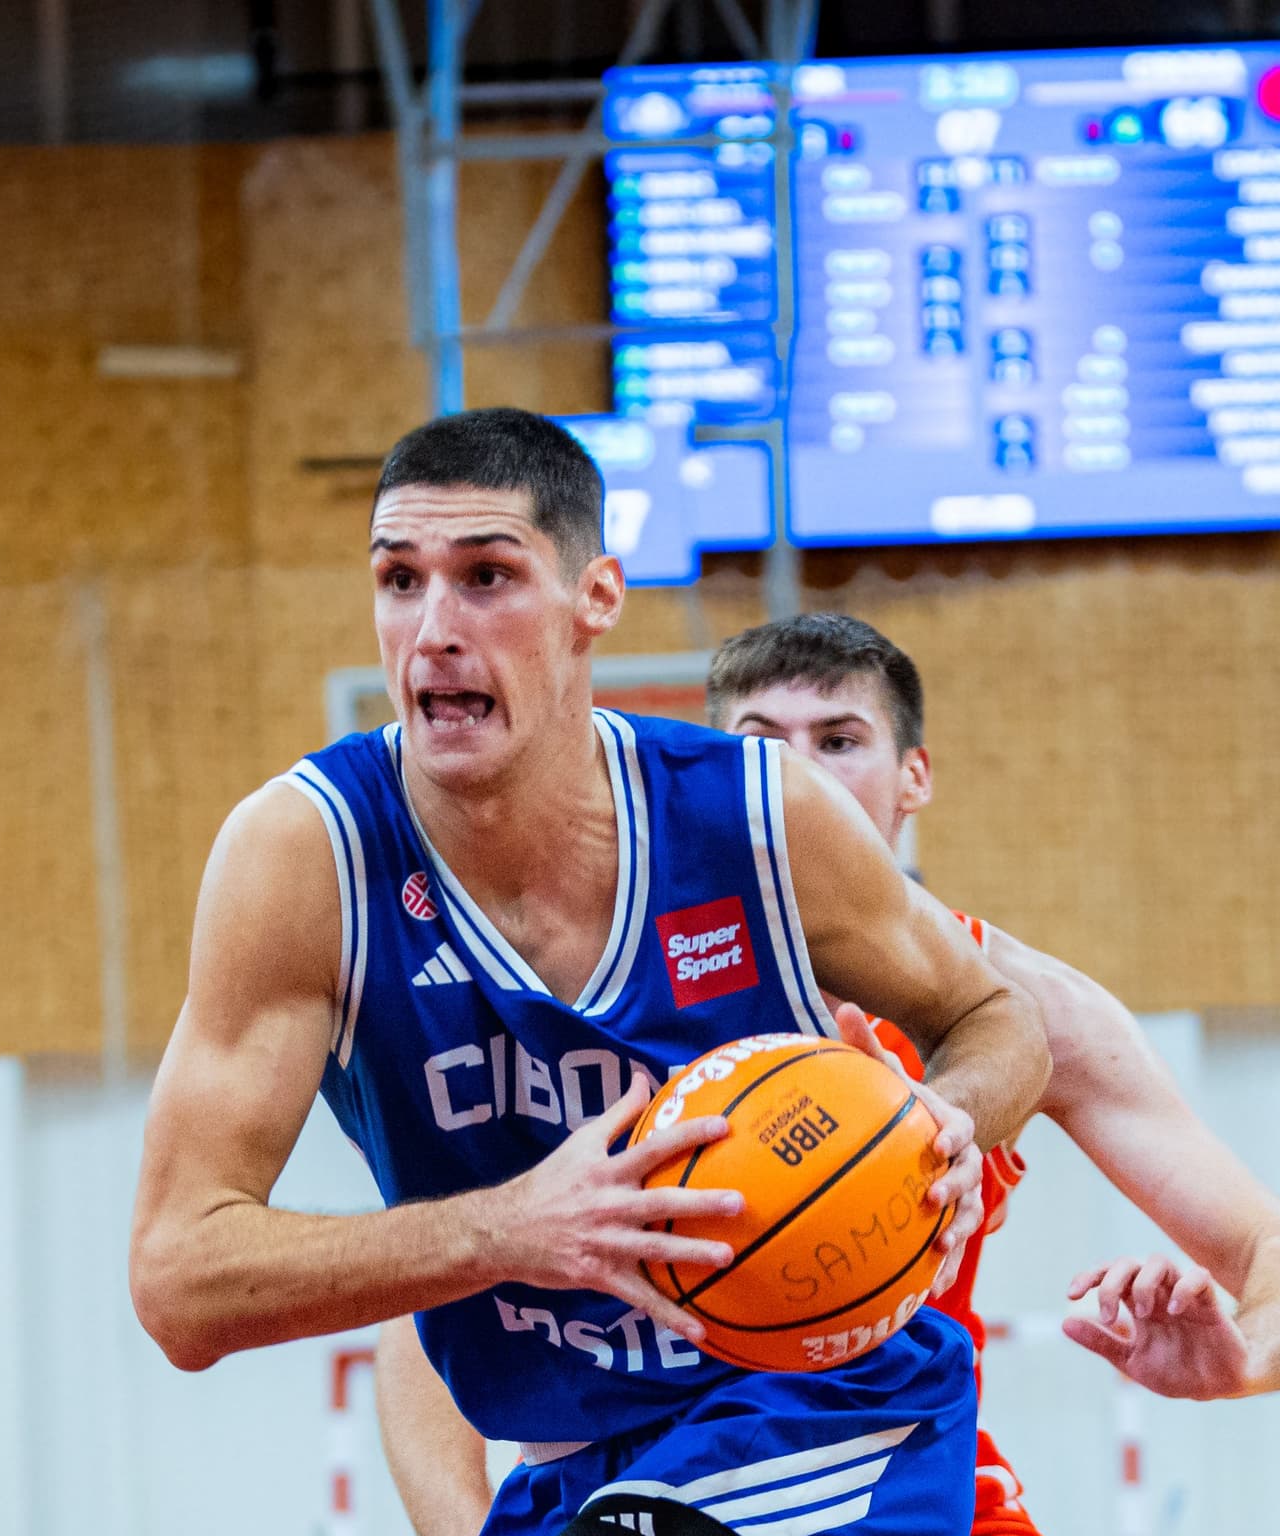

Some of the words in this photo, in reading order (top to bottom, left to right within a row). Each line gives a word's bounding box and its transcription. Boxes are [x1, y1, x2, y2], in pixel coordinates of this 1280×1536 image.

[667, 922, 742, 959] Super
[676, 943, 744, 982] Sport
[771, 1104, 840, 1167] FIBA
